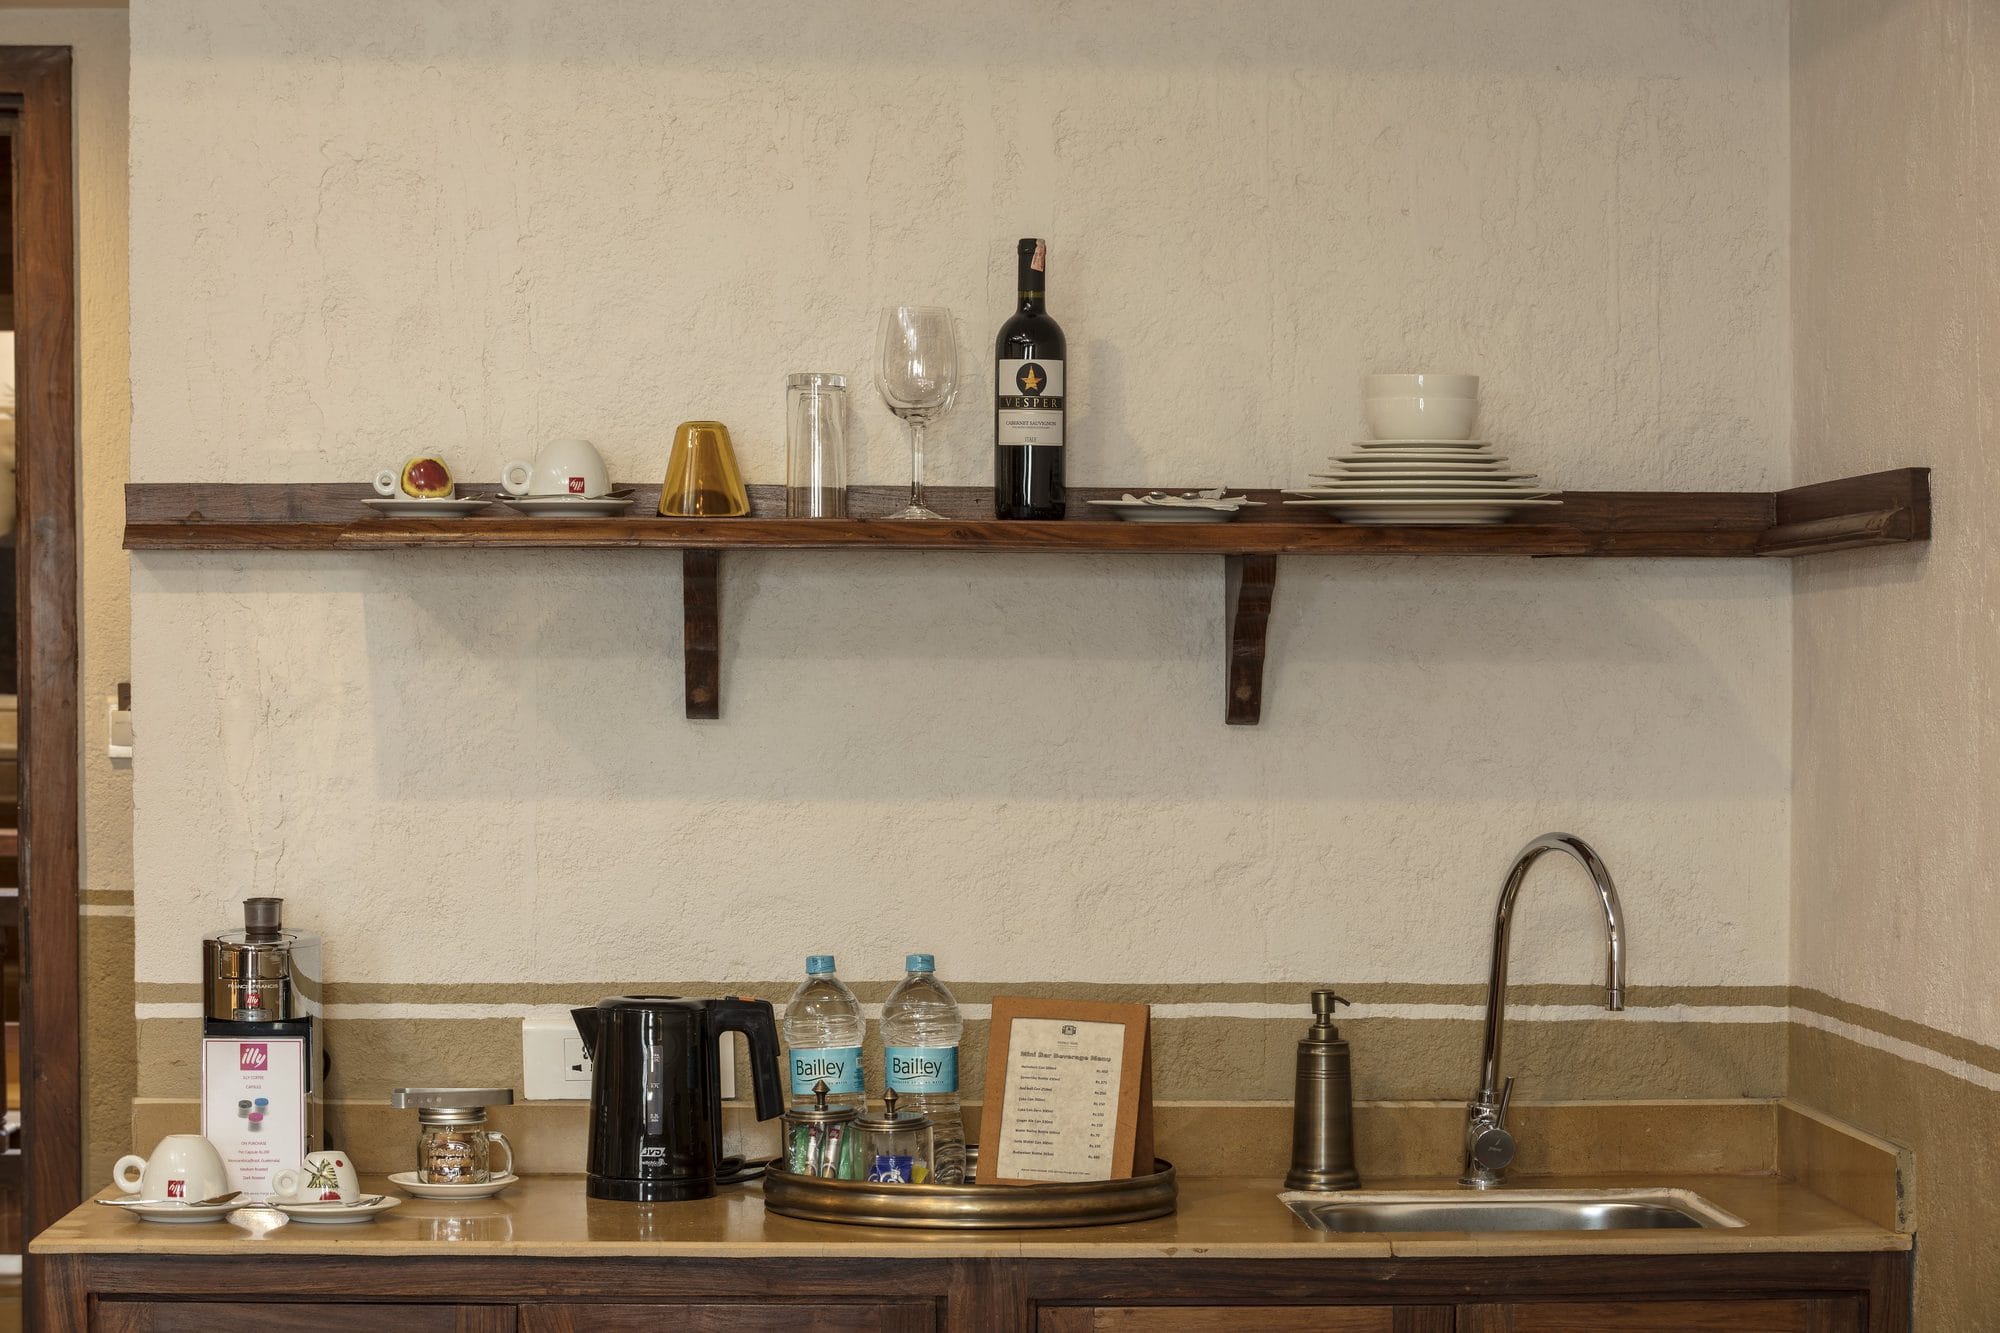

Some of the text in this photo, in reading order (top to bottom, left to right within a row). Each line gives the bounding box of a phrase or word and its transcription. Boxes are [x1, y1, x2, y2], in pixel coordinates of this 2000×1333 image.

[1005, 397, 1057, 408] VESPER
[241, 1047, 267, 1069] illy
[1019, 1050, 1037, 1058] Mini
[1053, 1053, 1089, 1062] Beverage
[795, 1057, 845, 1079] Bailley
[892, 1057, 943, 1078] Bailley
